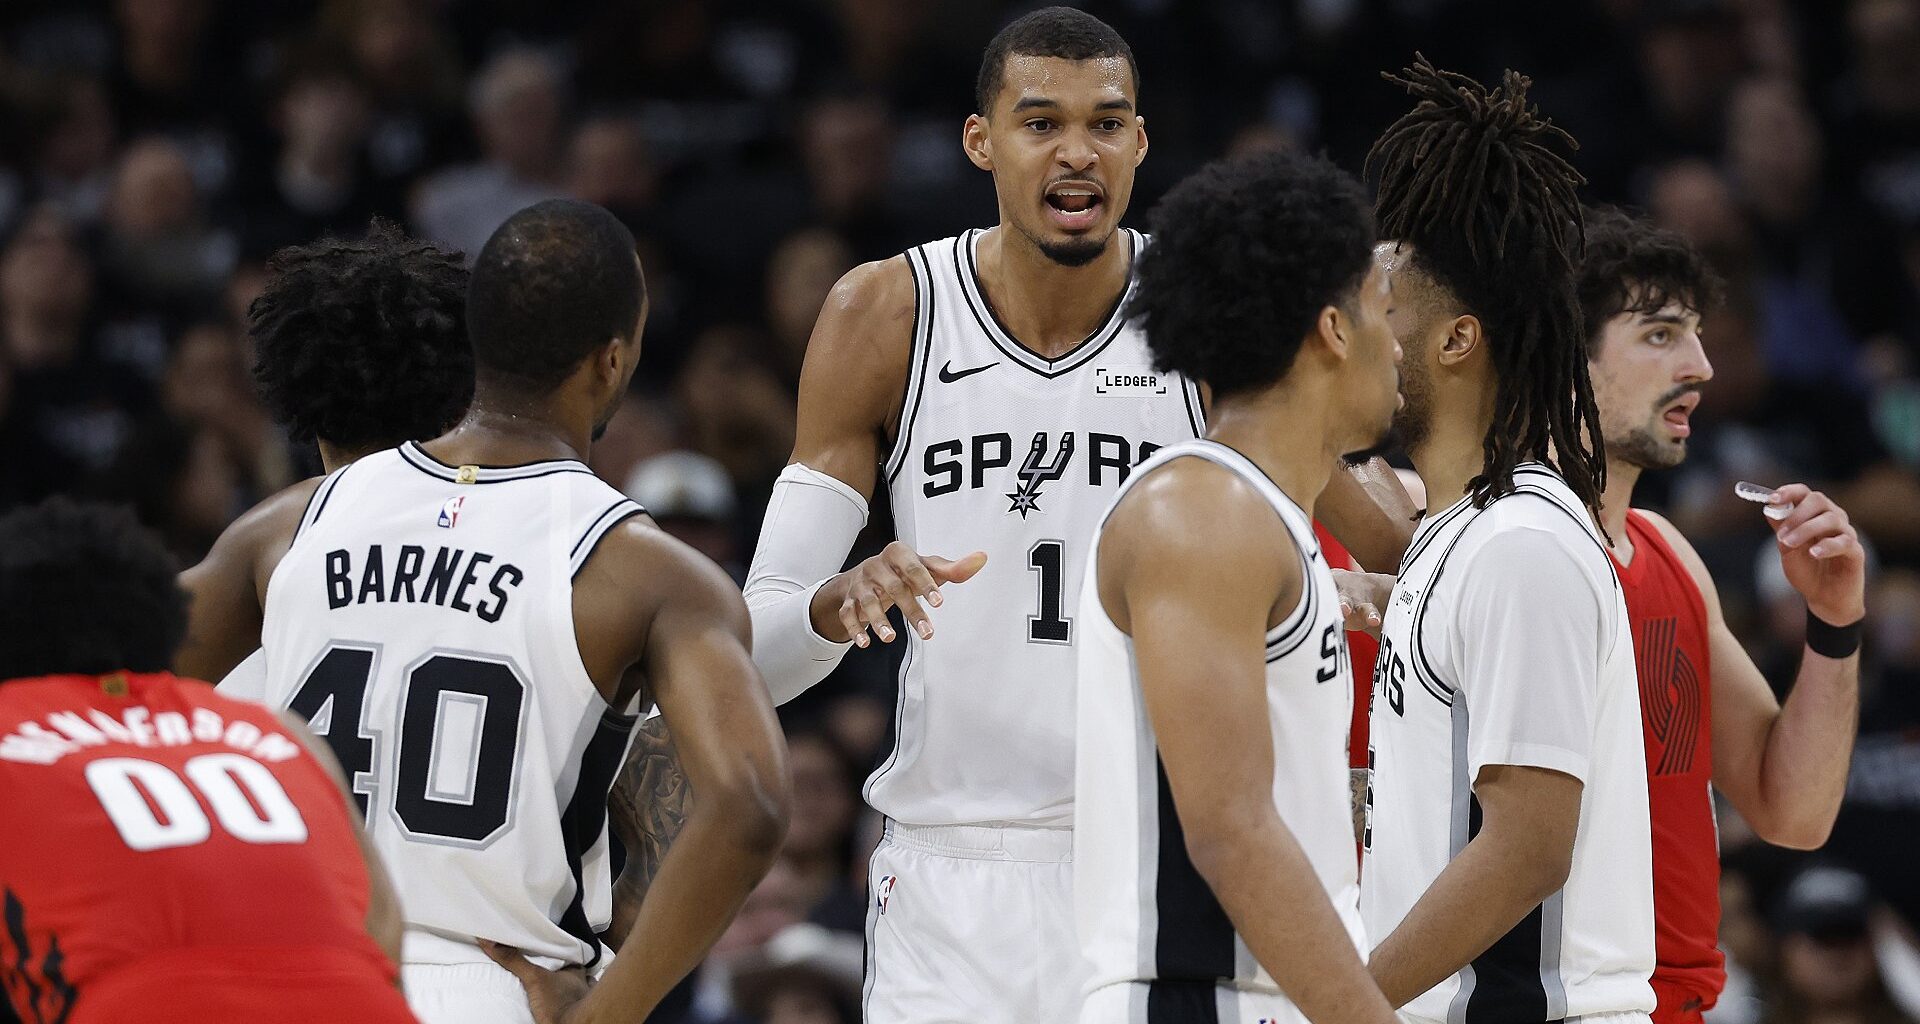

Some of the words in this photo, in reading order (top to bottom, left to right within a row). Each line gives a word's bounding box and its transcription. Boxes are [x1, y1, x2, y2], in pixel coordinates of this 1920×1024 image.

[1105, 375, 1157, 388] LEDGER
[923, 431, 1164, 521] SPUR
[325, 544, 524, 623] BARNES
[1027, 538, 1073, 646] 1
[282, 638, 533, 851] 40
[84, 752, 309, 852] 00
